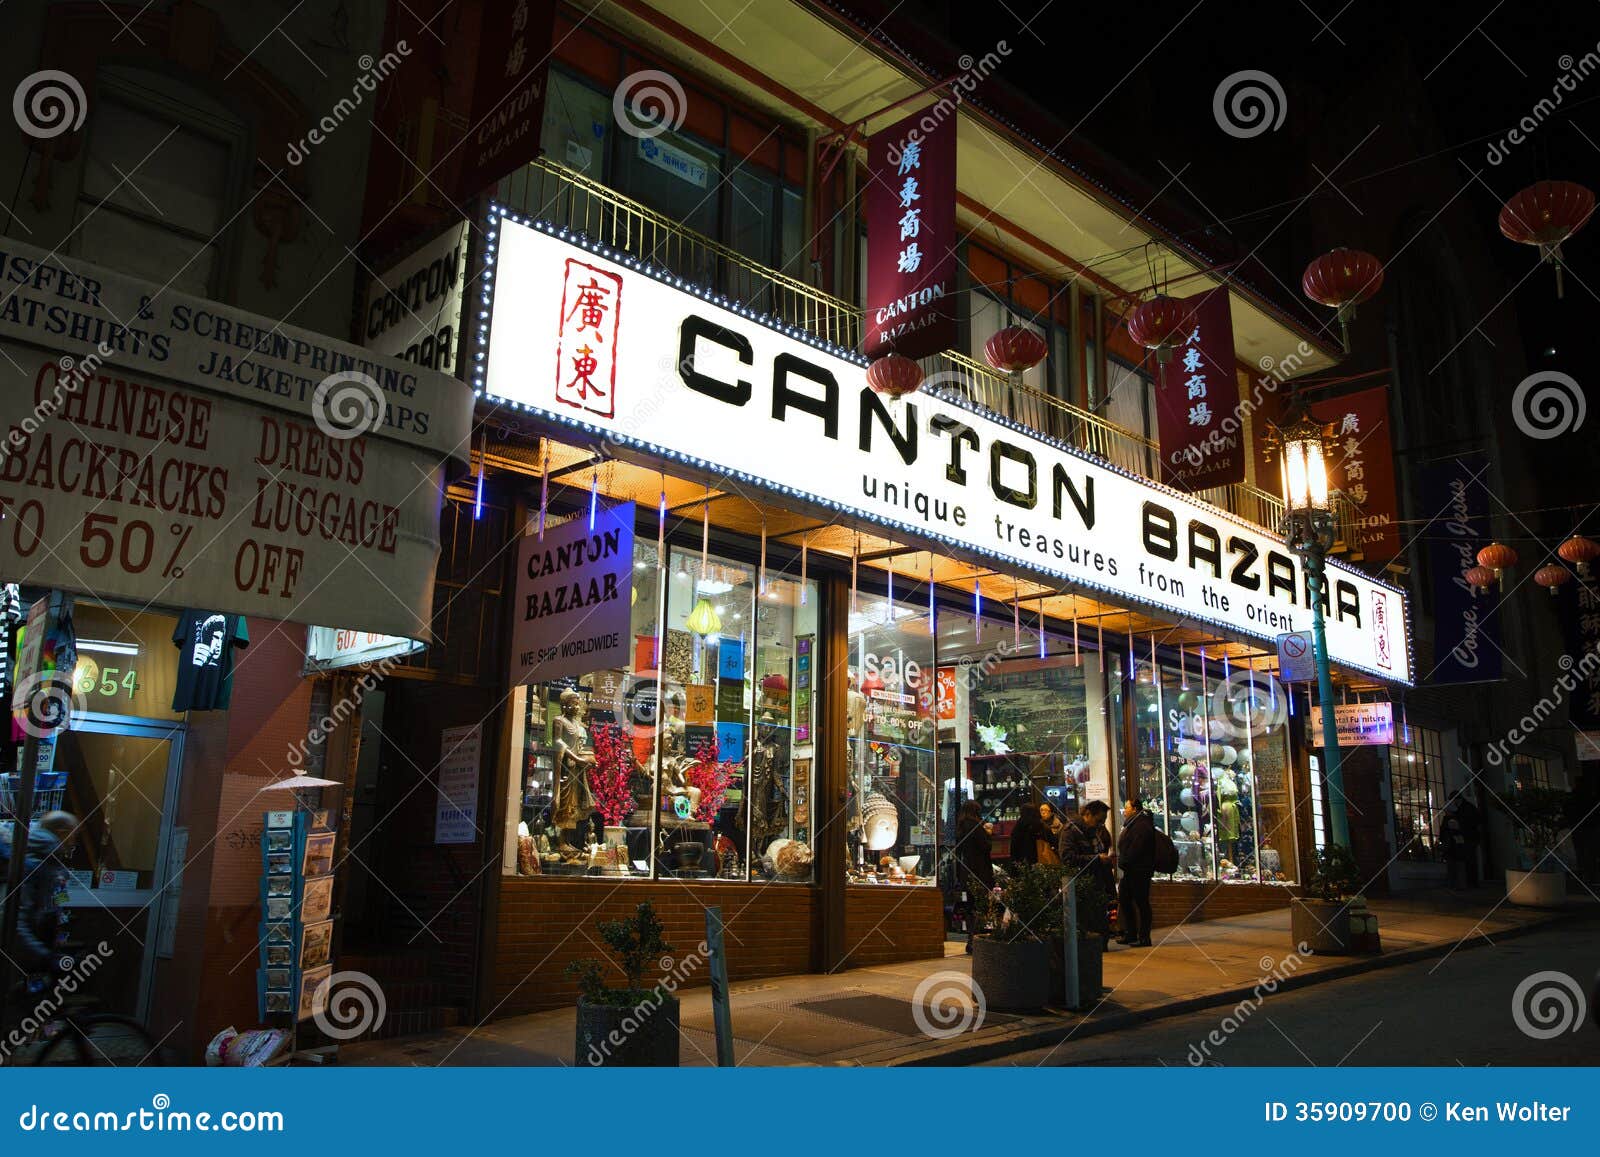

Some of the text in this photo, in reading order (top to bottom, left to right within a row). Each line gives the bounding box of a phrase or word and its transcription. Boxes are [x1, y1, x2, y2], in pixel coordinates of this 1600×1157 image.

[478, 77, 543, 145] CANTON
[898, 141, 923, 274] 廣東商場
[0, 292, 171, 361] ATSHIRTS
[368, 247, 461, 339] CANTON
[876, 281, 946, 325] CANTON
[880, 312, 937, 344] BAZAAR
[138, 296, 154, 320] &
[171, 304, 417, 398] SCREENPRINTING
[566, 277, 611, 400] 廣東
[34, 361, 369, 485] CHINESE DRESS
[677, 313, 1096, 531] CANTON
[0, 425, 399, 554] BACKPACKS LUGGAGE
[1359, 512, 1390, 529] TON
[80, 512, 193, 579] 50%
[235, 539, 304, 598] OFF
[527, 528, 621, 580] CANTON
[863, 474, 1294, 633] unique treasures from the orient
[524, 572, 619, 621] BAZAAR
[77, 664, 139, 699] 654
[520, 632, 619, 667] WE SHIP WORLDWIDE
